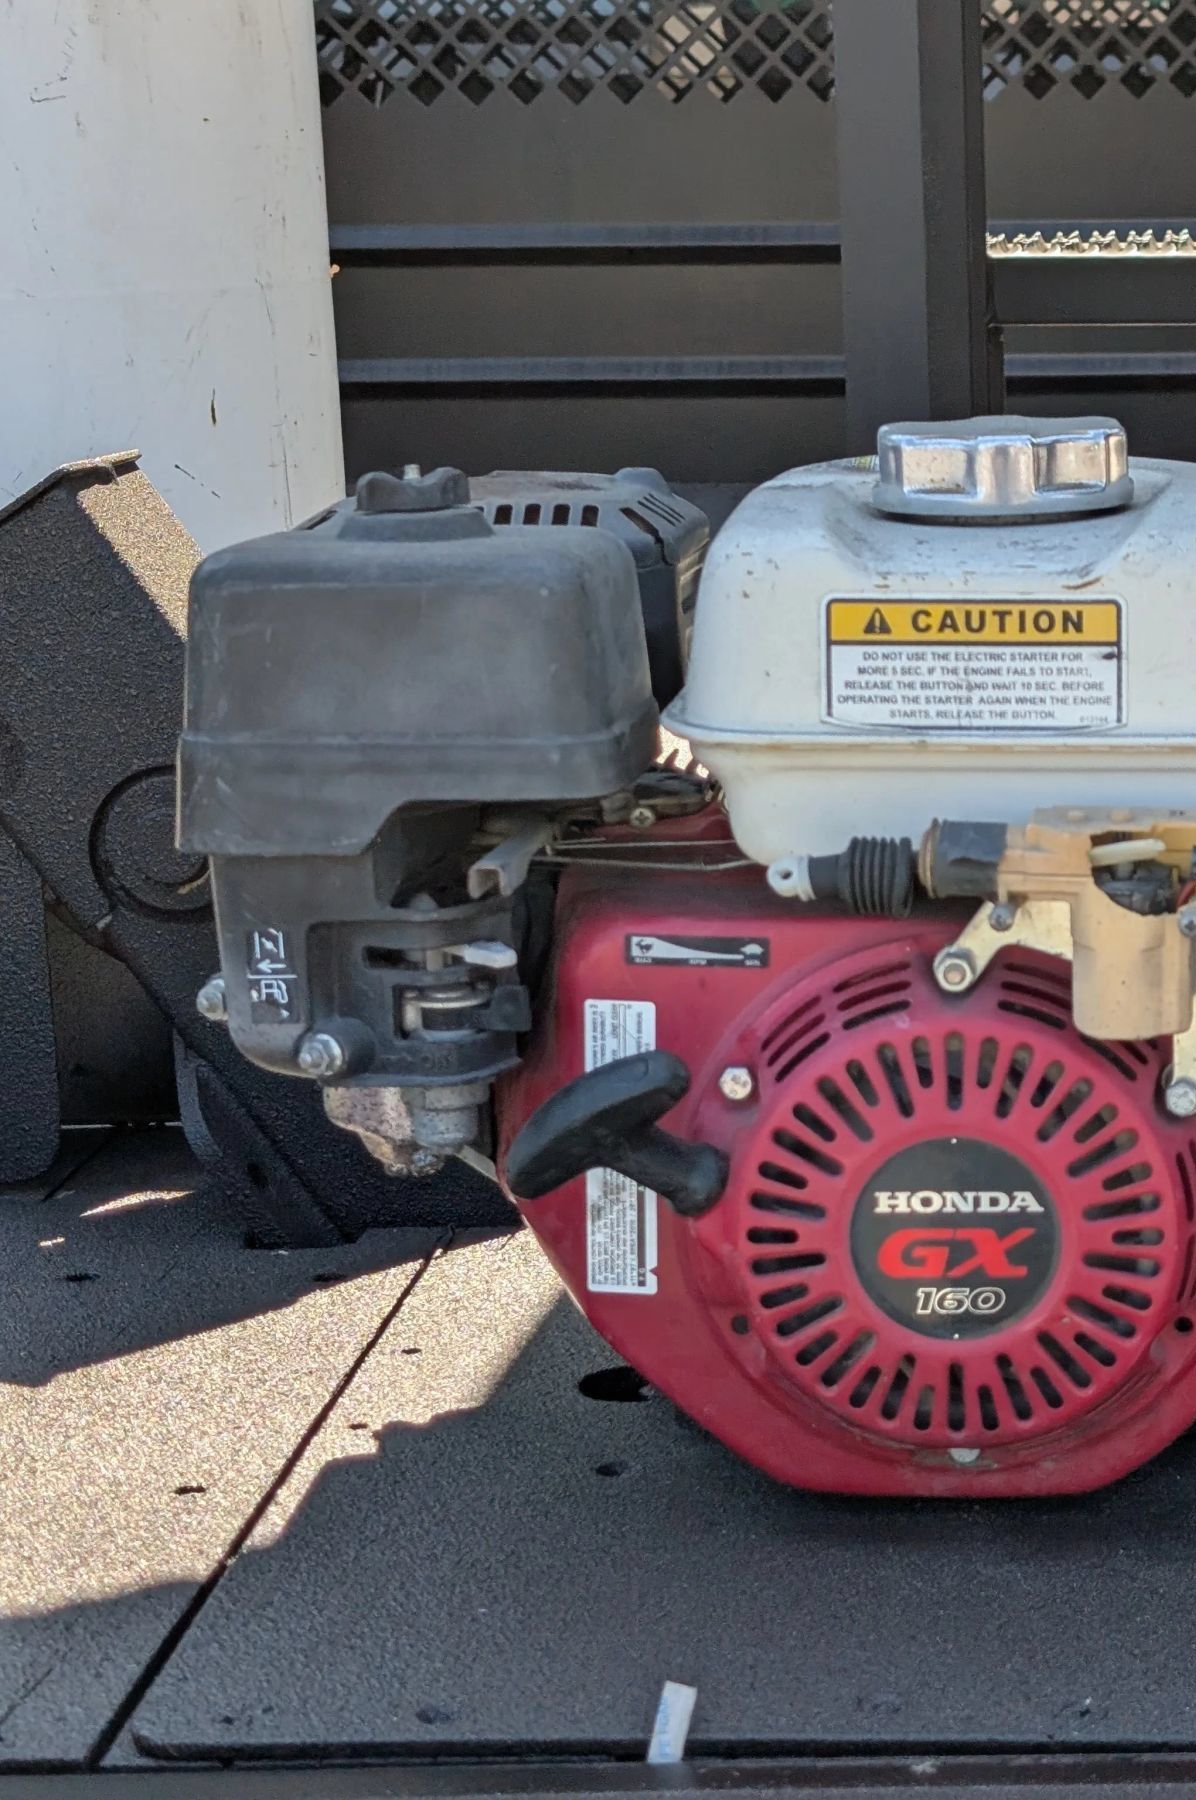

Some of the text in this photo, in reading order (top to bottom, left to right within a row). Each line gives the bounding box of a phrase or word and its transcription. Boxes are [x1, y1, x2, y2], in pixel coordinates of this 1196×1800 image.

[911, 609, 1084, 633] CAUTION
[863, 652, 1083, 661] DO NOT USE THE ELECTRIC STARTER FOR
[857, 666, 888, 676] MORE
[927, 666, 936, 676] IF
[941, 666, 959, 676] THE
[963, 666, 1003, 676] ENGINE
[1007, 666, 1036, 676] FAILS
[1040, 667, 1054, 677] TO
[844, 681, 893, 690] RELEASE
[896, 681, 918, 690] THE
[920, 681, 963, 690] BUTTON
[964, 681, 989, 690] AND
[992, 682, 1016, 691] WAIT
[1061, 682, 1104, 691] BEFORE
[837, 695, 1112, 705] OPERATING THE STARTER AGAIN WHEN THE ENGINE
[936, 709, 985, 719] RELEASE
[988, 710, 1009, 720] THE
[873, 1190, 1045, 1213] HONDA
[877, 1227, 1037, 1279] GX
[916, 1286, 1006, 1315] 160
